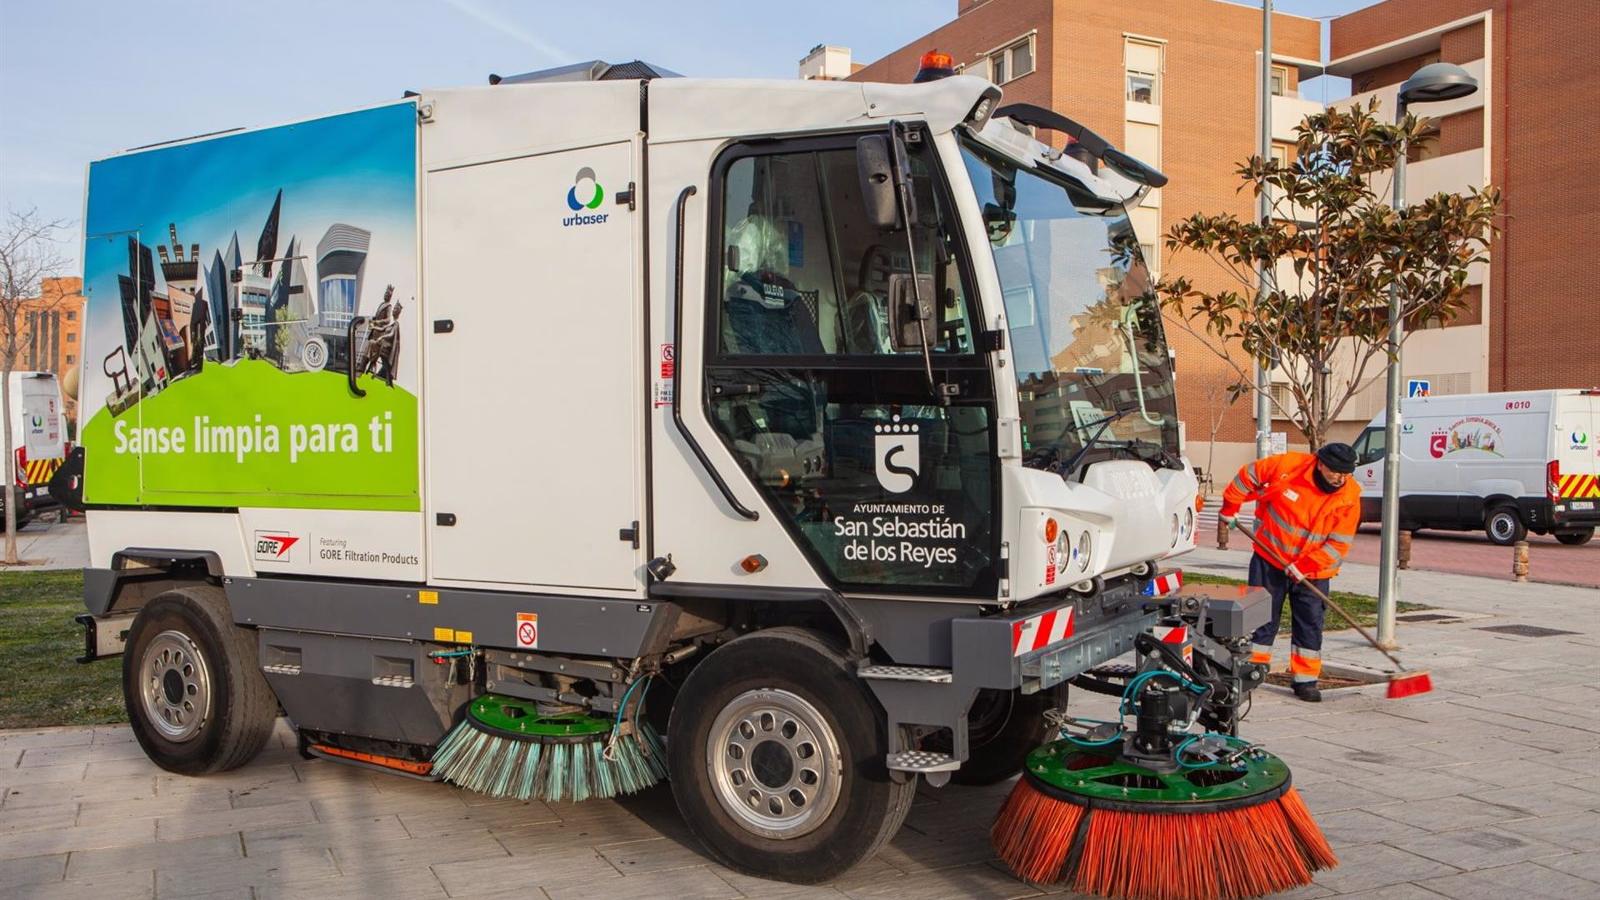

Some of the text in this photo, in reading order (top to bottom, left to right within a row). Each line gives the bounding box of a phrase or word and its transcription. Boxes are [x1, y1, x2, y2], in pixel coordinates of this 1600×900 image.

[563, 212, 609, 227] urbaser
[1514, 401, 1531, 409] 010
[114, 411, 393, 463] Sanse limpia para ti
[853, 504, 945, 514] AYUNTAMIENTO DE
[834, 516, 966, 539] San Sebastián
[257, 540, 278, 553] GORE
[320, 537, 347, 548] Featuring
[320, 549, 419, 565] GORE Filtration Products
[844, 539, 957, 568] de los Reyes
